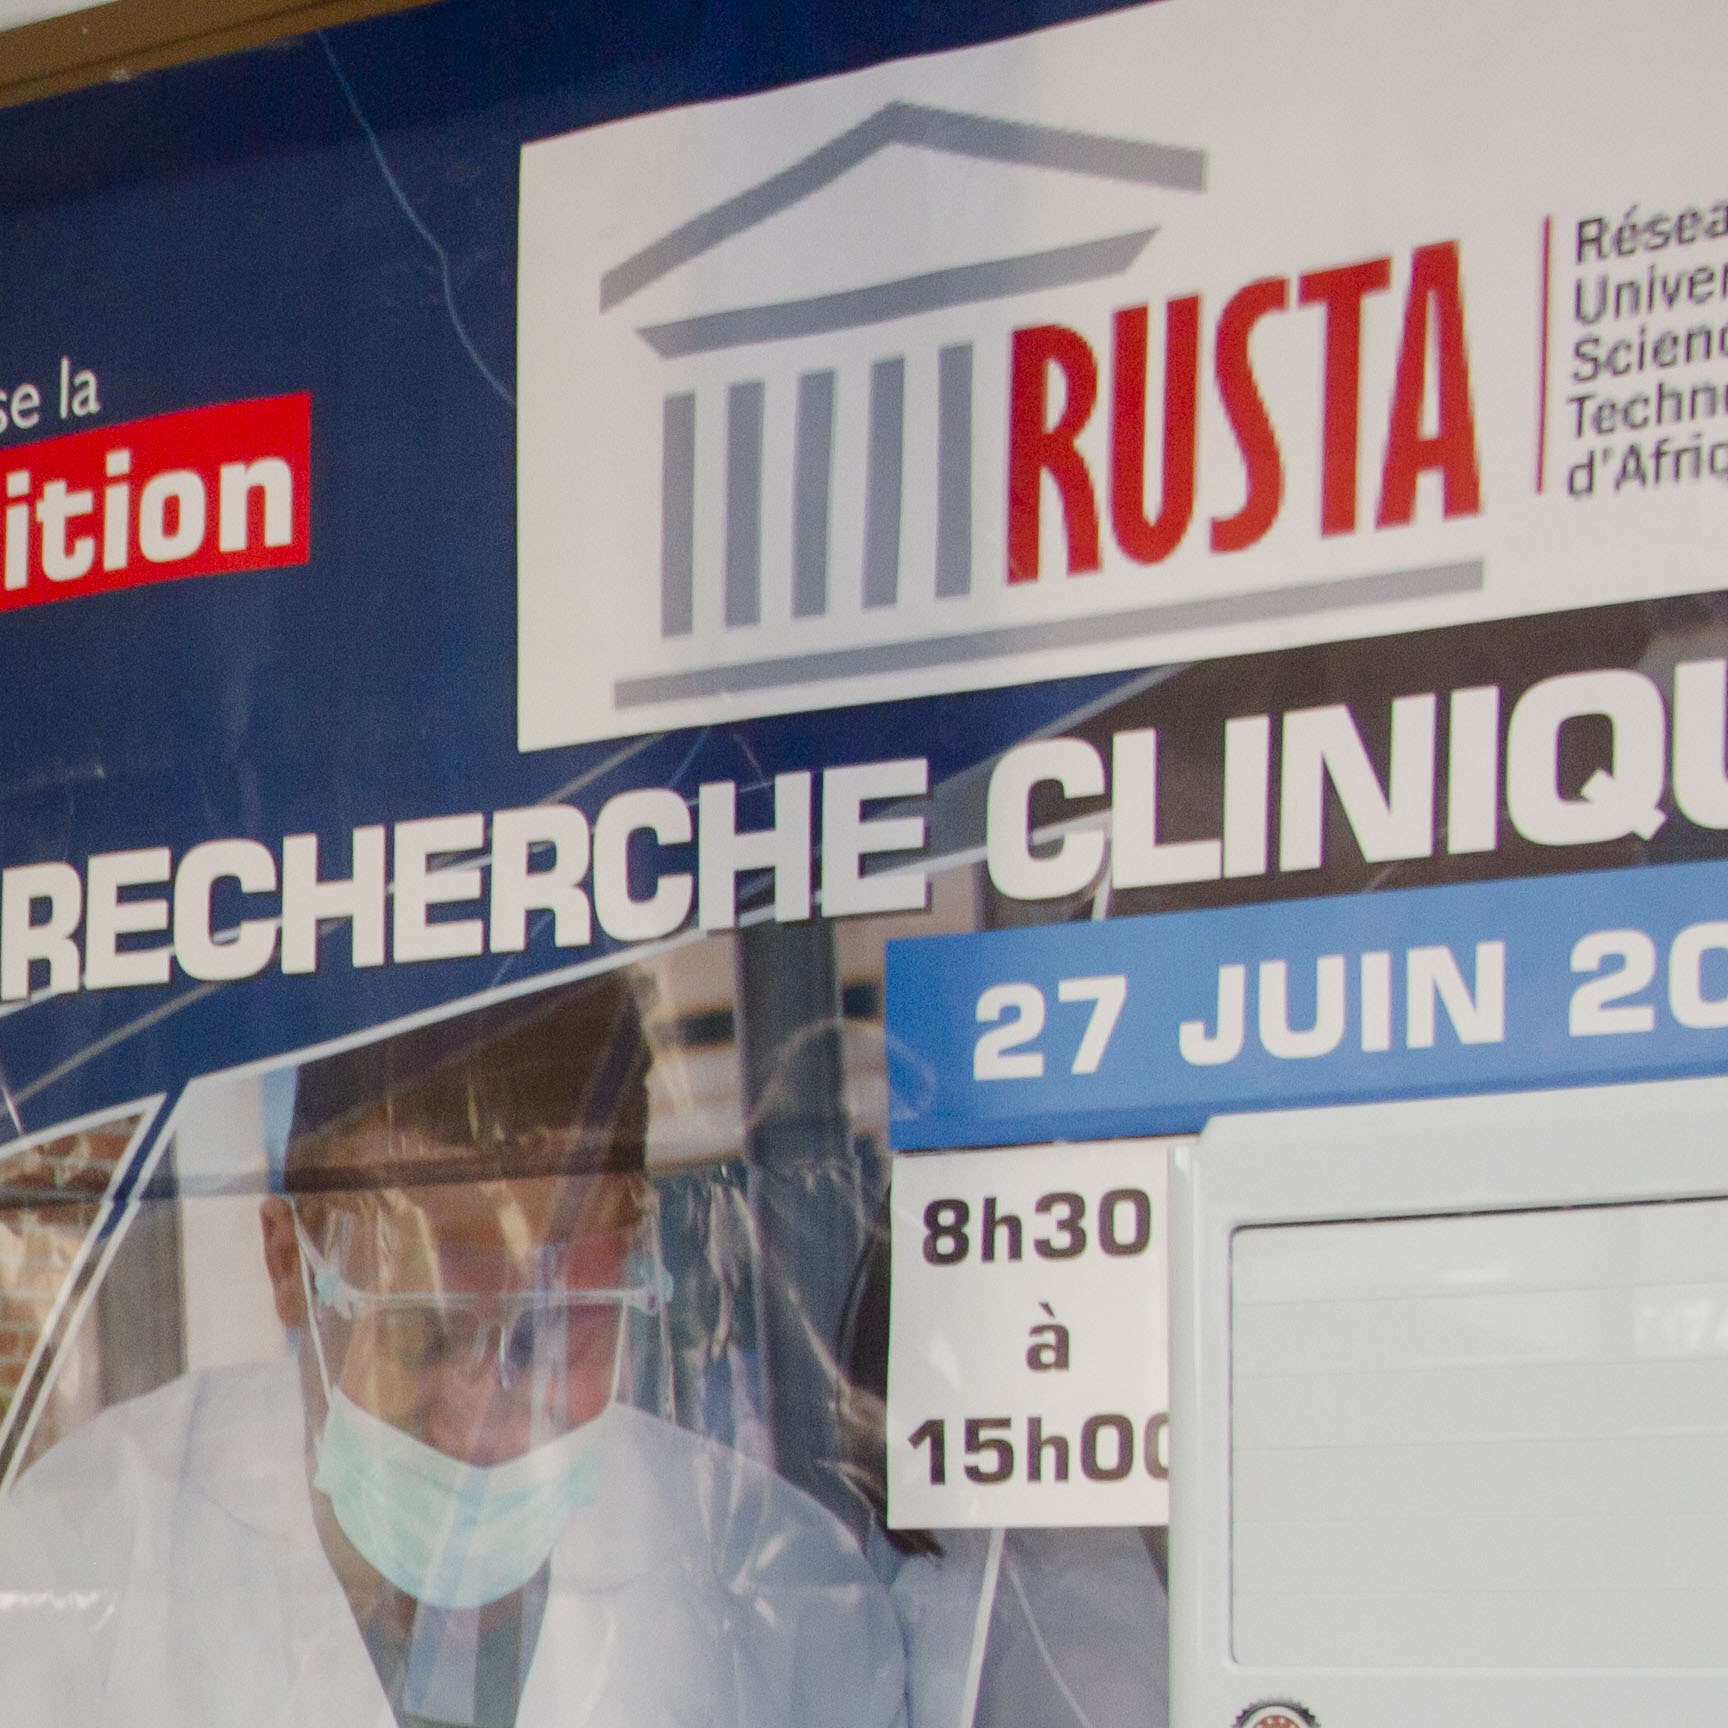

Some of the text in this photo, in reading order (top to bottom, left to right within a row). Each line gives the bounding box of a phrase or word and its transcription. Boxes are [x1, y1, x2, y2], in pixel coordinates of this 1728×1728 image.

[60, 357, 99, 418] la
[1005, 239, 1484, 585] RUSTA
[1567, 381, 1728, 438] Techn
[1, 758, 929, 1001] RECHERCHE
[974, 975, 1128, 1081] 27
[1178, 941, 1506, 1067] JUIN
[922, 1188, 1152, 1266] 8h30
[1025, 1303, 1072, 1373] à
